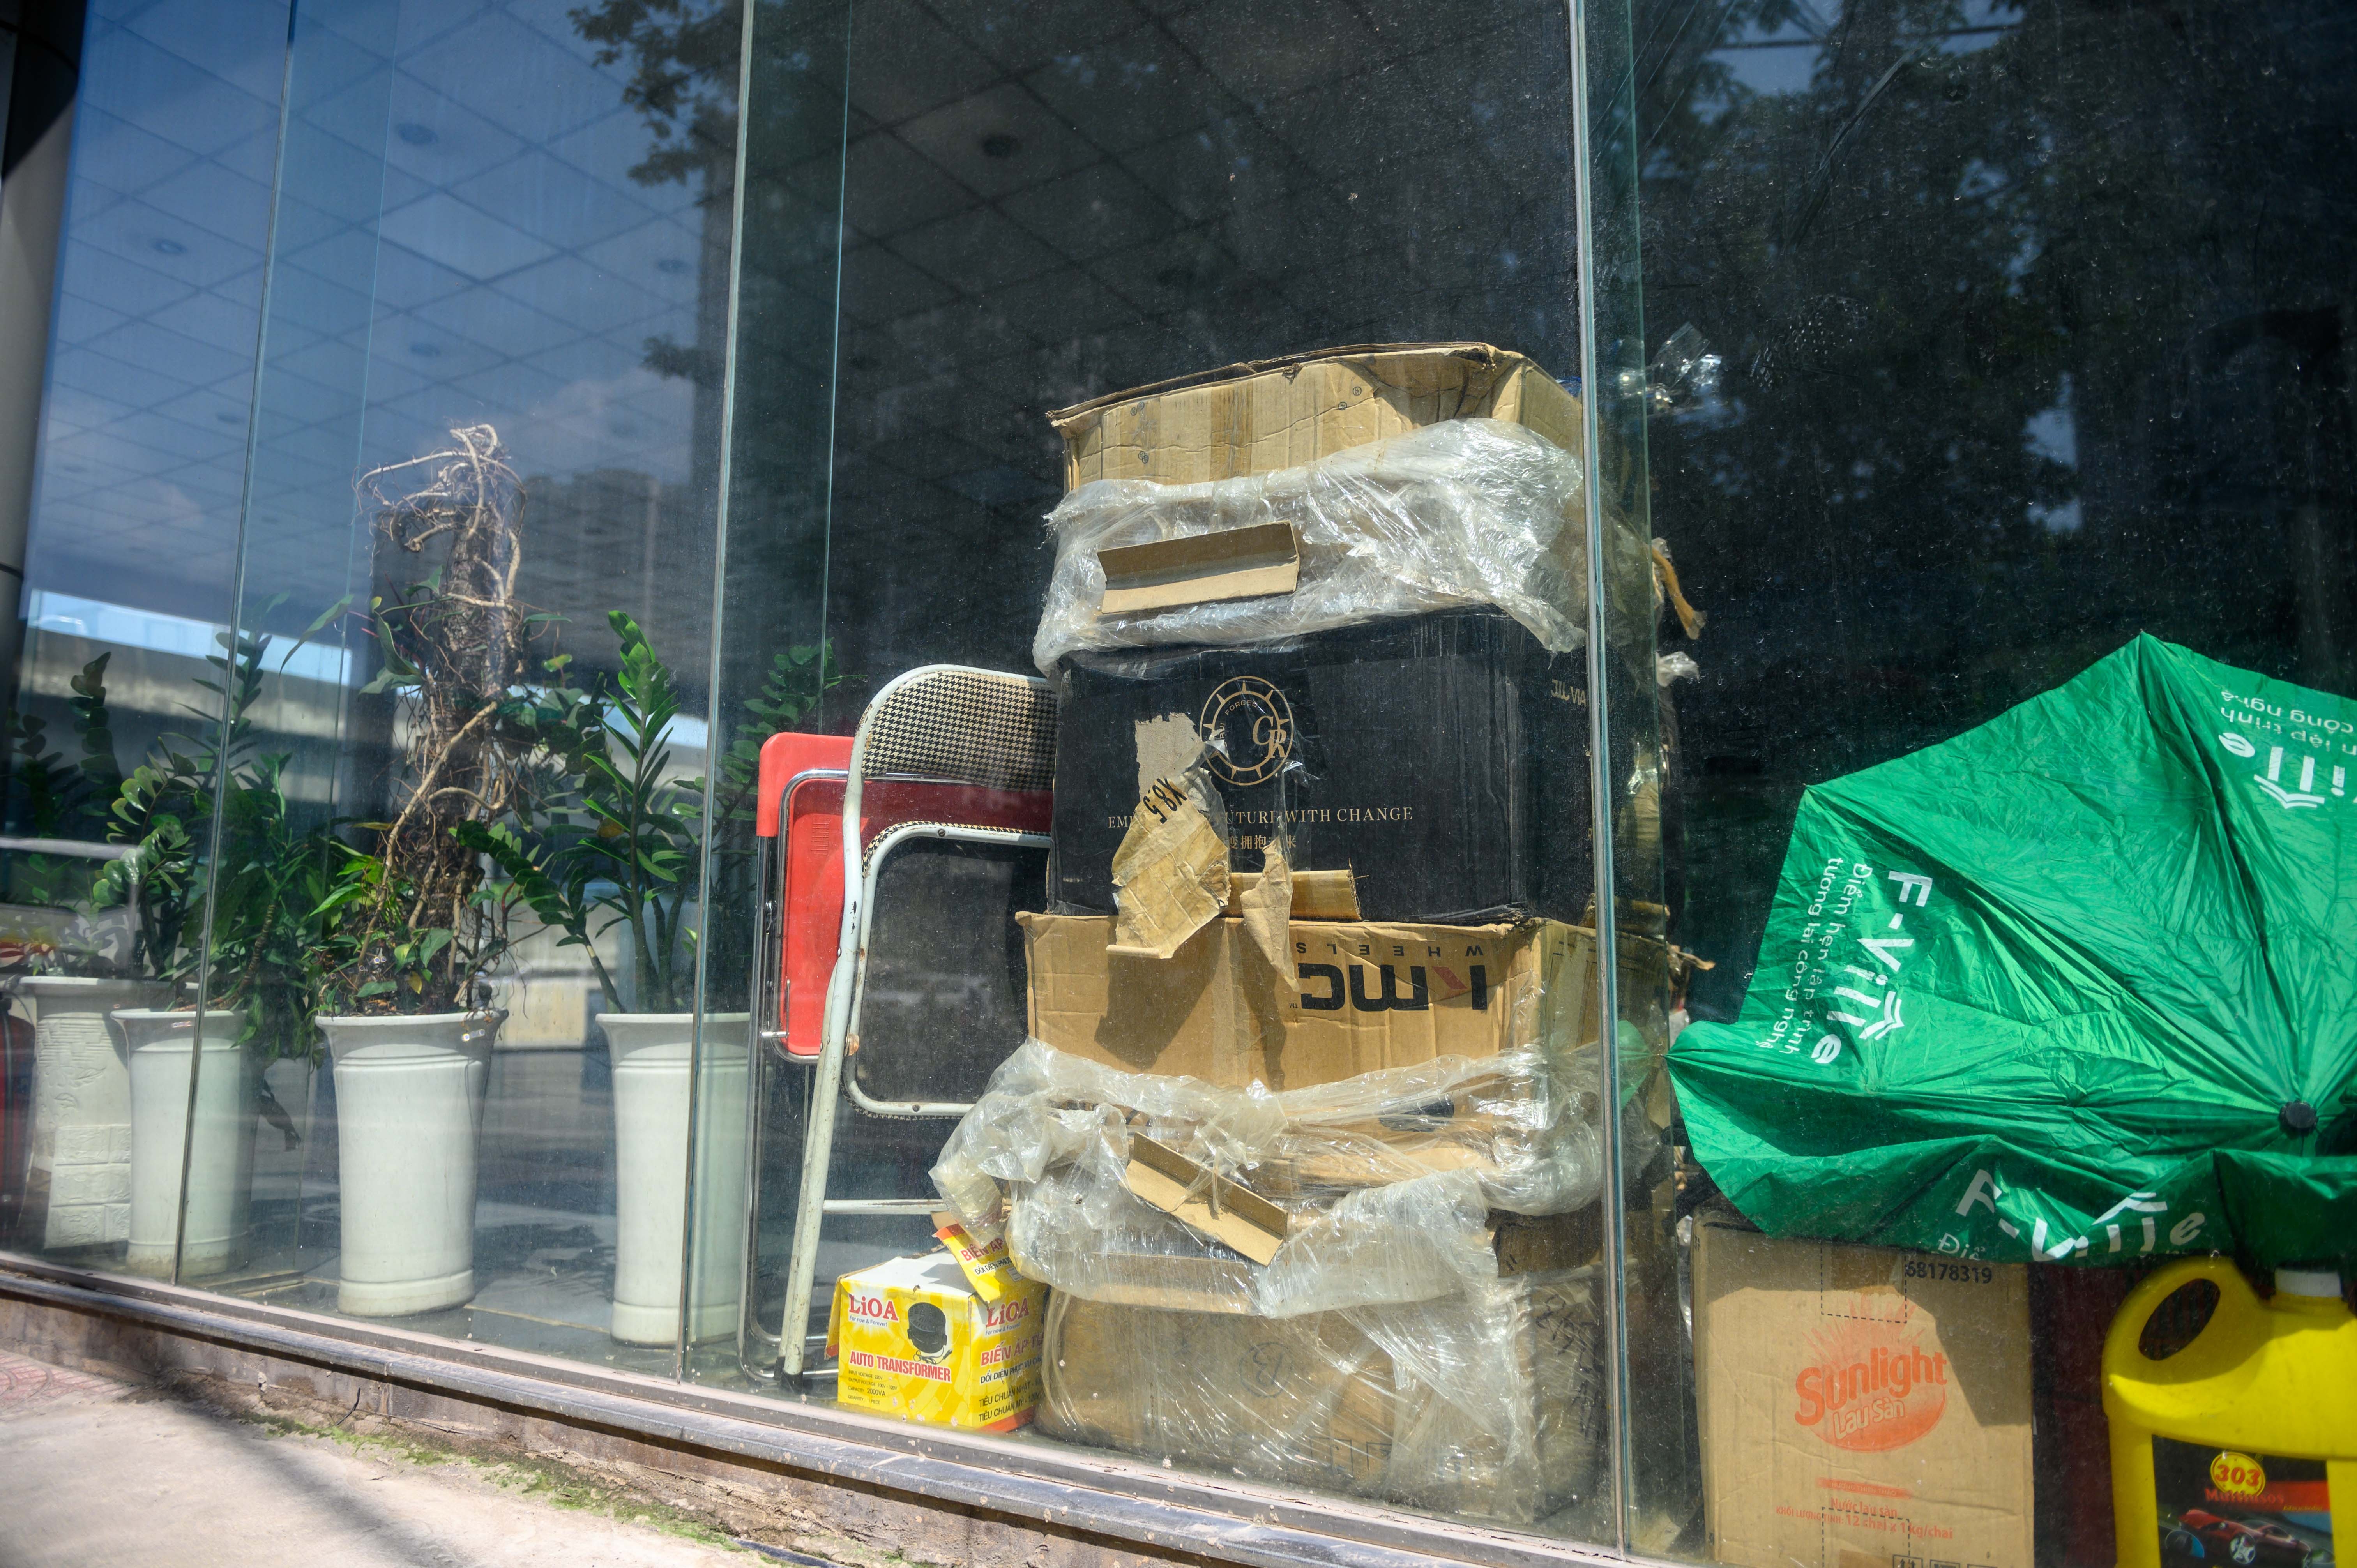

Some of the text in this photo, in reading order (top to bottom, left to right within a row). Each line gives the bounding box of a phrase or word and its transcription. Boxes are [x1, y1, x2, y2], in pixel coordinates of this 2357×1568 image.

[1226, 807, 1413, 824] UTURE WITH CHANGE
[1808, 857, 1844, 917] tương
[1833, 862, 1873, 915] Điểm
[1801, 922, 1820, 945] lai
[1818, 922, 1846, 961] hẹn
[1296, 941, 1484, 957] WHEELS
[1785, 950, 1808, 1001] công
[1905, 1261, 1992, 1284] 68178319
[848, 1294, 898, 1321] LiOA
[986, 1297, 1029, 1328] LiOA
[981, 1340, 1012, 1366] BIẾN
[1014, 1338, 1028, 1356] ÁP
[849, 1351, 951, 1382] AUTO TRANSFORMER
[867, 1388, 886, 1397] 2000VA
[1794, 1345, 1948, 1427] Sunlight
[979, 1395, 993, 1407] TIÊU
[979, 1410, 993, 1422] TIÊU
[1833, 1396, 1905, 1439] Lau Sàn
[2215, 1464, 2261, 1487] 303
[1831, 1497, 1898, 1518] Nước lau sàn
[1776, 1505, 1794, 1517] KHỐI
[1796, 1509, 1822, 1521] LƯỢNG
[1846, 1514, 1860, 1527] 12
[1863, 1517, 1887, 1531] chai
[1890, 1522, 1897, 1532] x
[1909, 1522, 1953, 1539] kg/chai
